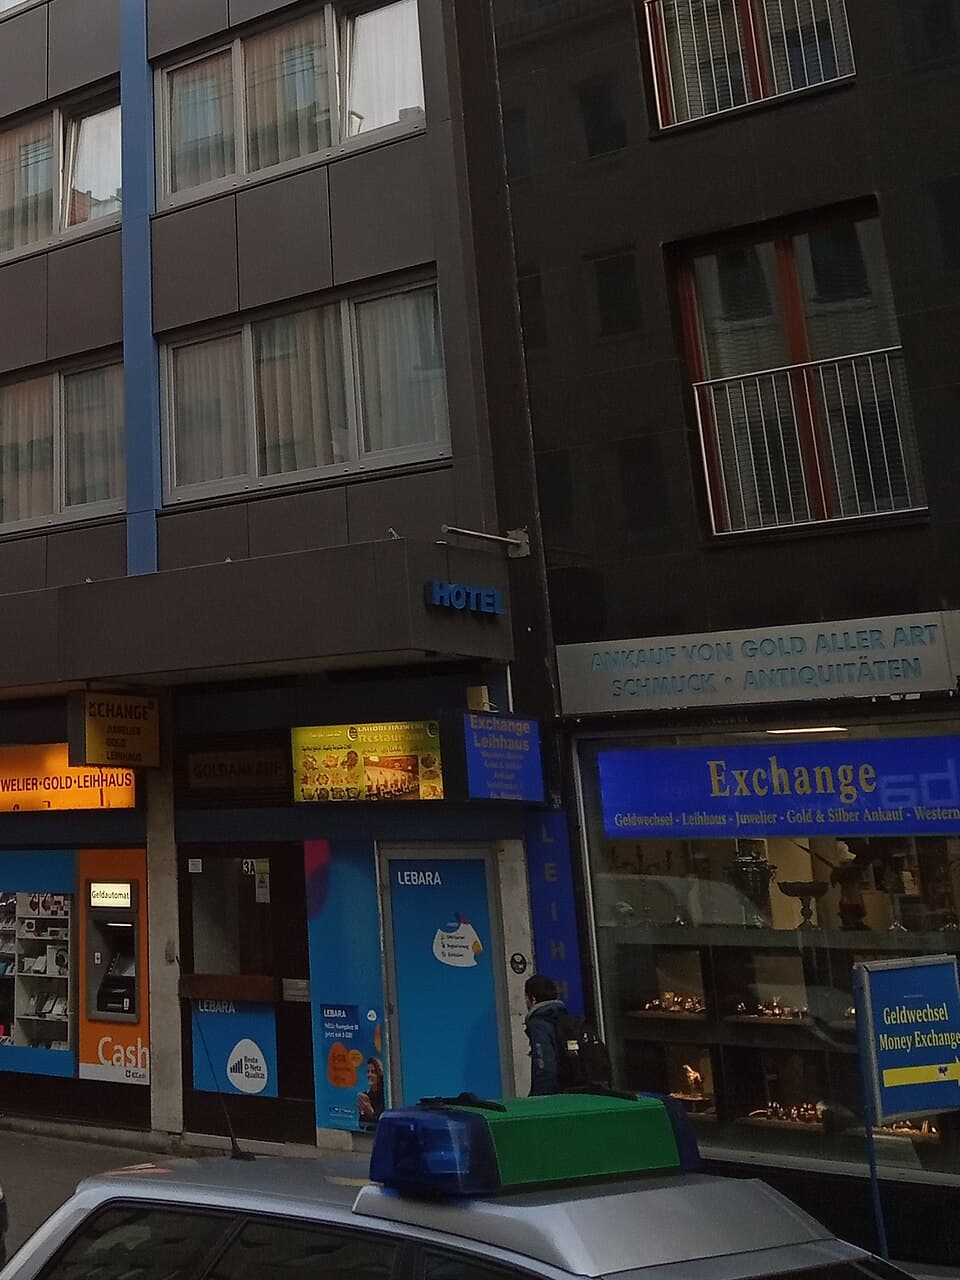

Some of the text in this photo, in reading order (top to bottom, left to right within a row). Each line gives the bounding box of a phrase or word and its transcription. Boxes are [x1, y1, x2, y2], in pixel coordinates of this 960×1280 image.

[431, 579, 505, 616] HOTEL
[591, 624, 938, 673] ANKAUF VON GOLD ALLER ART
[612, 656, 921, 697] SCHMUCK ANTIQUITÄTEN
[470, 714, 531, 736] Exchange
[473, 731, 530, 751] Leihhaus
[706, 756, 877, 804] Exchange
[614, 812, 674, 828] Geldwechsel
[682, 811, 727, 826] Leihhaus
[735, 811, 777, 829] Juwelier
[786, 809, 814, 824] Gold
[816, 809, 826, 823] &
[828, 806, 860, 822] Silber
[863, 805, 904, 821] Ankauf
[914, 804, 960, 821] Western
[243, 861, 256, 874] 3A
[397, 871, 442, 886] LEBARA
[91, 890, 130, 901] Geldautomat
[198, 999, 236, 1014] LEBARA
[323, 1008, 347, 1018] LEBARA
[883, 1002, 949, 1025] Geldwechsel
[879, 1028, 960, 1053] Money Exchange
[97, 1036, 150, 1069] Cash
